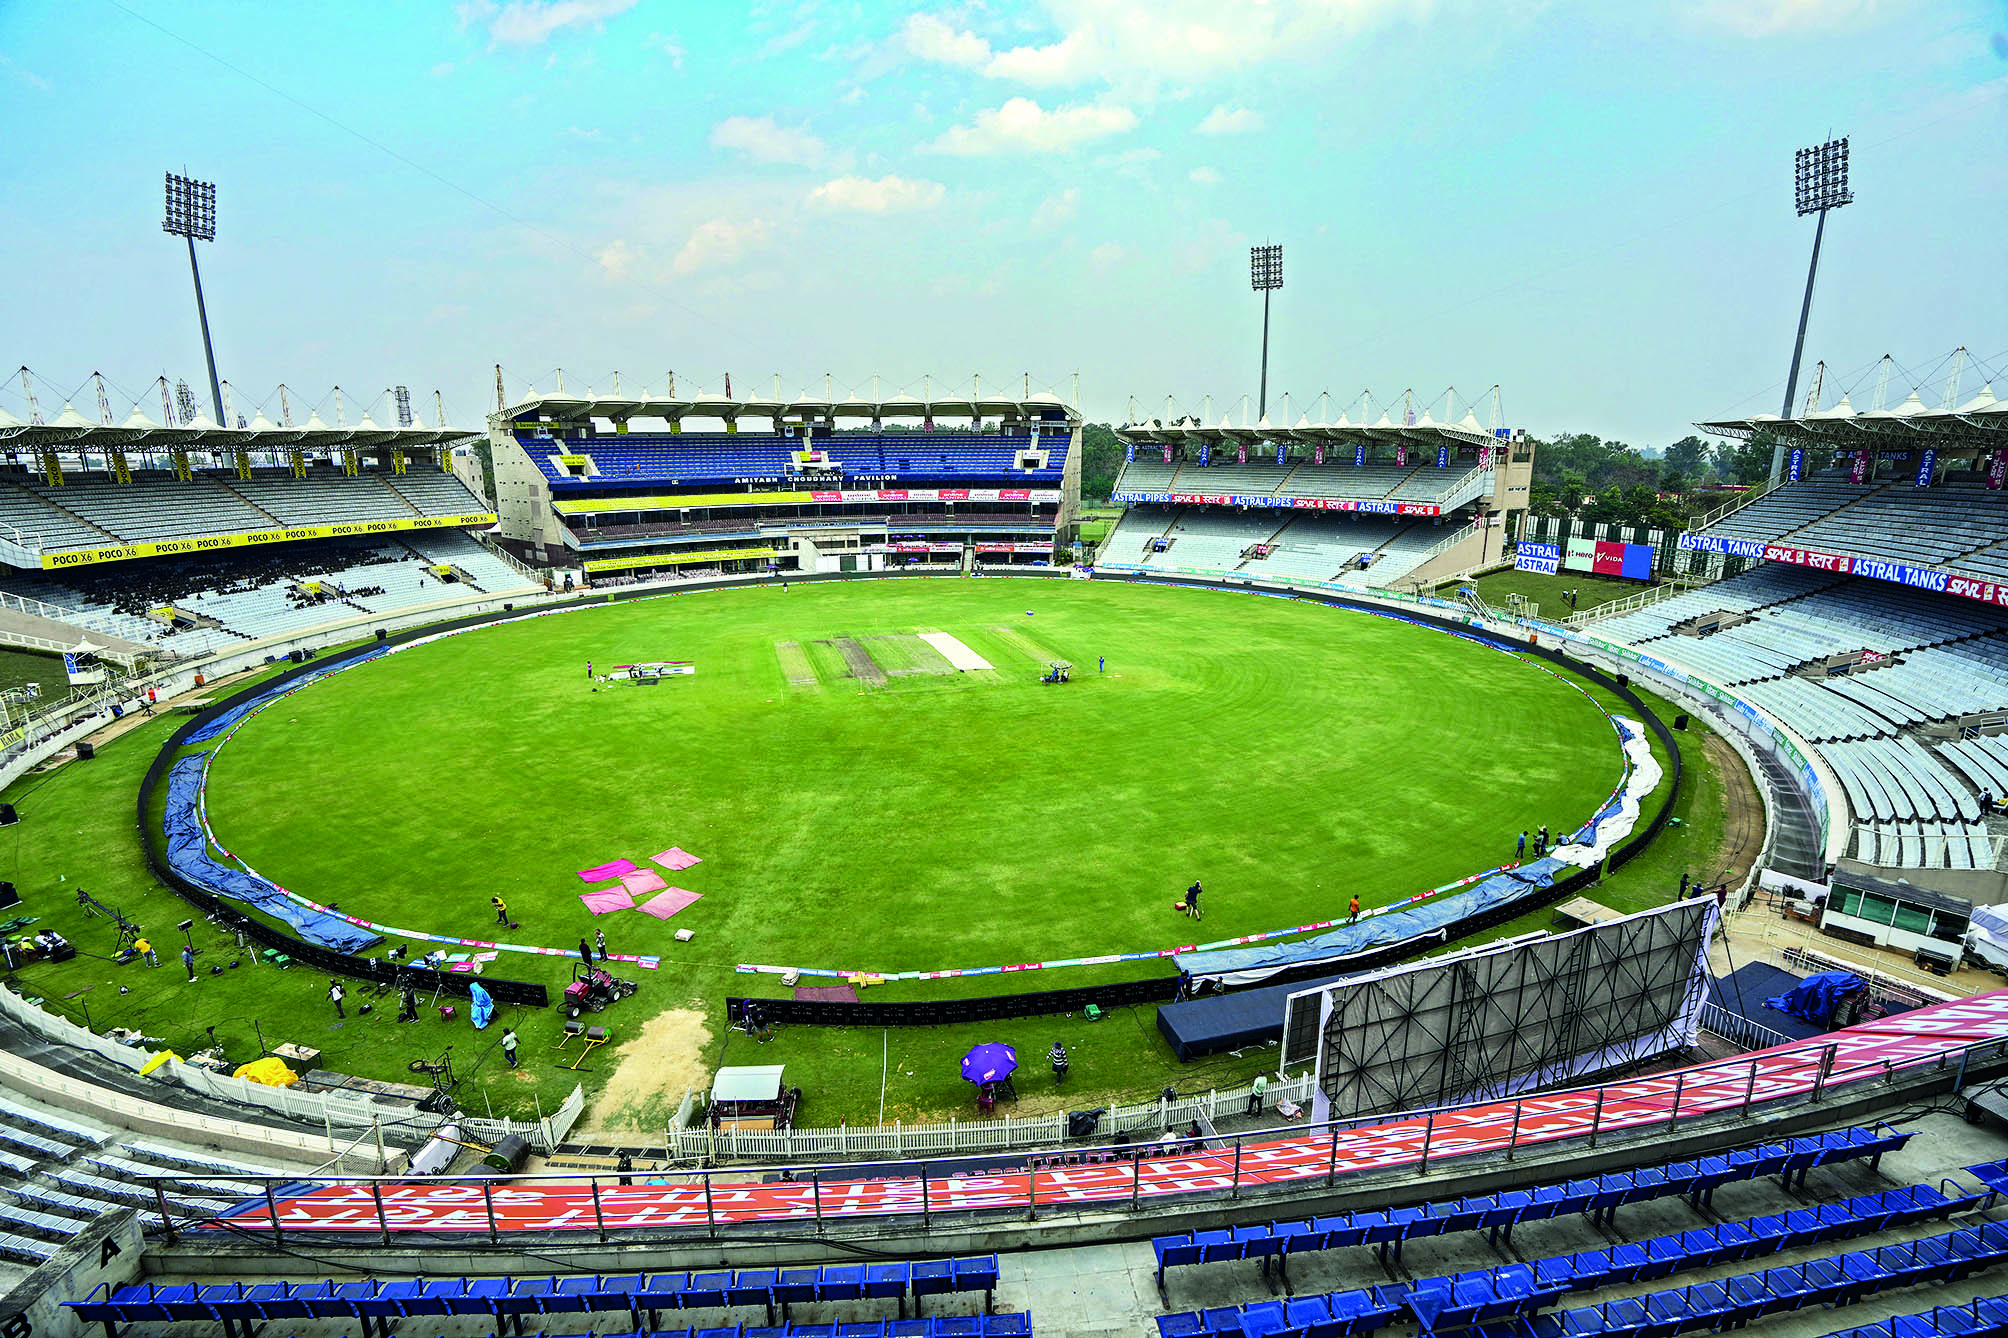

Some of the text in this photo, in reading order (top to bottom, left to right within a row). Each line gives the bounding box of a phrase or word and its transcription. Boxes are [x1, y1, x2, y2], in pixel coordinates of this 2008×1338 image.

[1880, 452, 1908, 460] TANKS
[1789, 449, 1800, 481] ASTRAL
[1919, 449, 1934, 486] ASTRAL
[853, 474, 898, 482] PAVILION
[1113, 493, 1170, 502] ASTRAL PIPES
[1173, 495, 1194, 503] STAR
[1235, 497, 1291, 507] ASTRAL PIPES
[1295, 499, 1318, 507] STAR
[1359, 503, 1396, 513] ASTRAL
[1403, 505, 1428, 515] STAR
[367, 522, 398, 531] POCO X6
[414, 518, 442, 527] POCO X6
[285, 528, 317, 539] POCO X6
[332, 525, 363, 534] POCO X6
[197, 537, 232, 548] POCO X6
[247, 532, 281, 543] POCO X6
[155, 541, 192, 552] POCO X6
[1517, 543, 1560, 559] ASTRAL
[1681, 535, 1765, 559] ASTRAL TANKS
[52, 552, 93, 566] POCO X6
[98, 547, 137, 560] POCO X6
[1764, 547, 1795, 563] STAR
[1515, 558, 1556, 574] ASTRAL
[1852, 559, 1947, 592] ASTRAL TANKS
[1946, 579, 1982, 599] STAR
[100, 1236, 122, 1270] A
[1, 1312, 33, 1338] B
